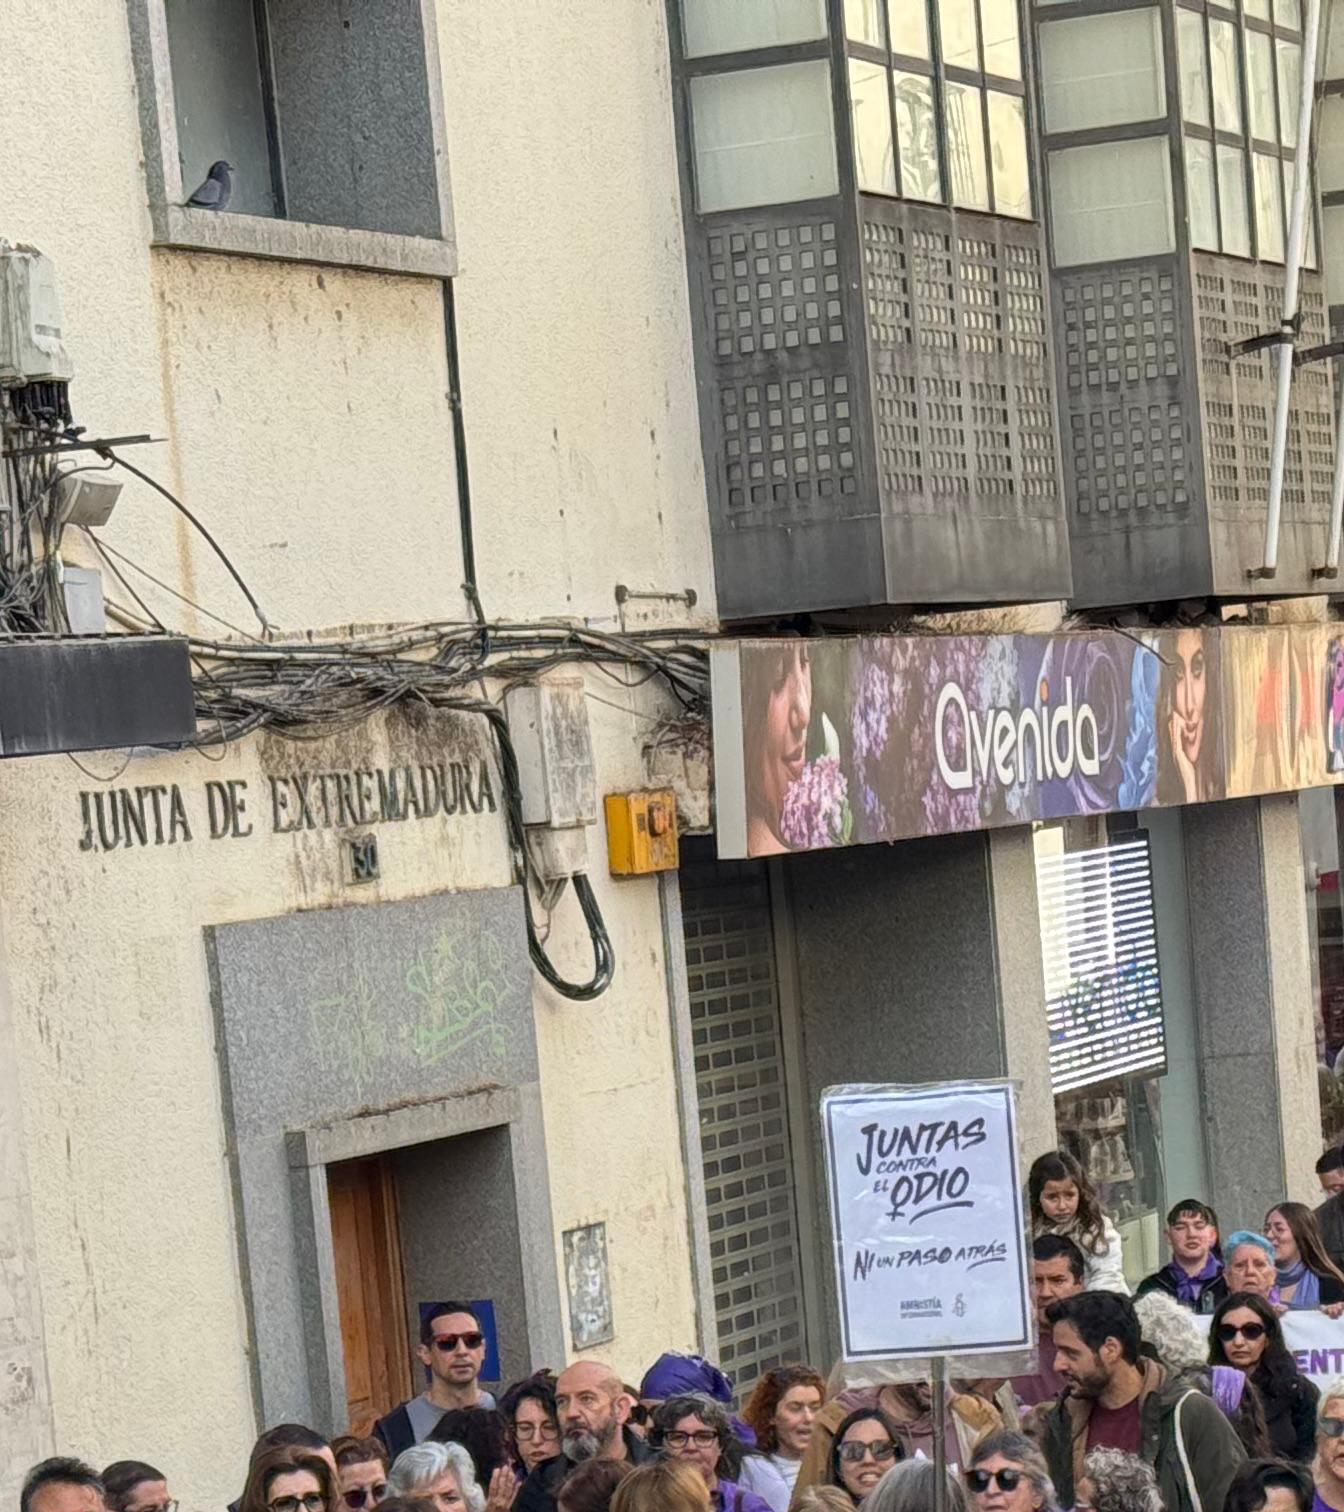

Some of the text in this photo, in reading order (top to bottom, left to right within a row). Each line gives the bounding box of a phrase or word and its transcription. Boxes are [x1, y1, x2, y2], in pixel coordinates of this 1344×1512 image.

[79, 762, 497, 852] JUNTA DE EXTREMADURA
[856, 1117, 987, 1176] JUNTAS
[876, 1156, 938, 1174] CONTRA
[873, 1166, 970, 1213] EL ODIO
[854, 1249, 876, 1281] NI
[877, 1254, 896, 1269] UN
[896, 1246, 953, 1269] PASO
